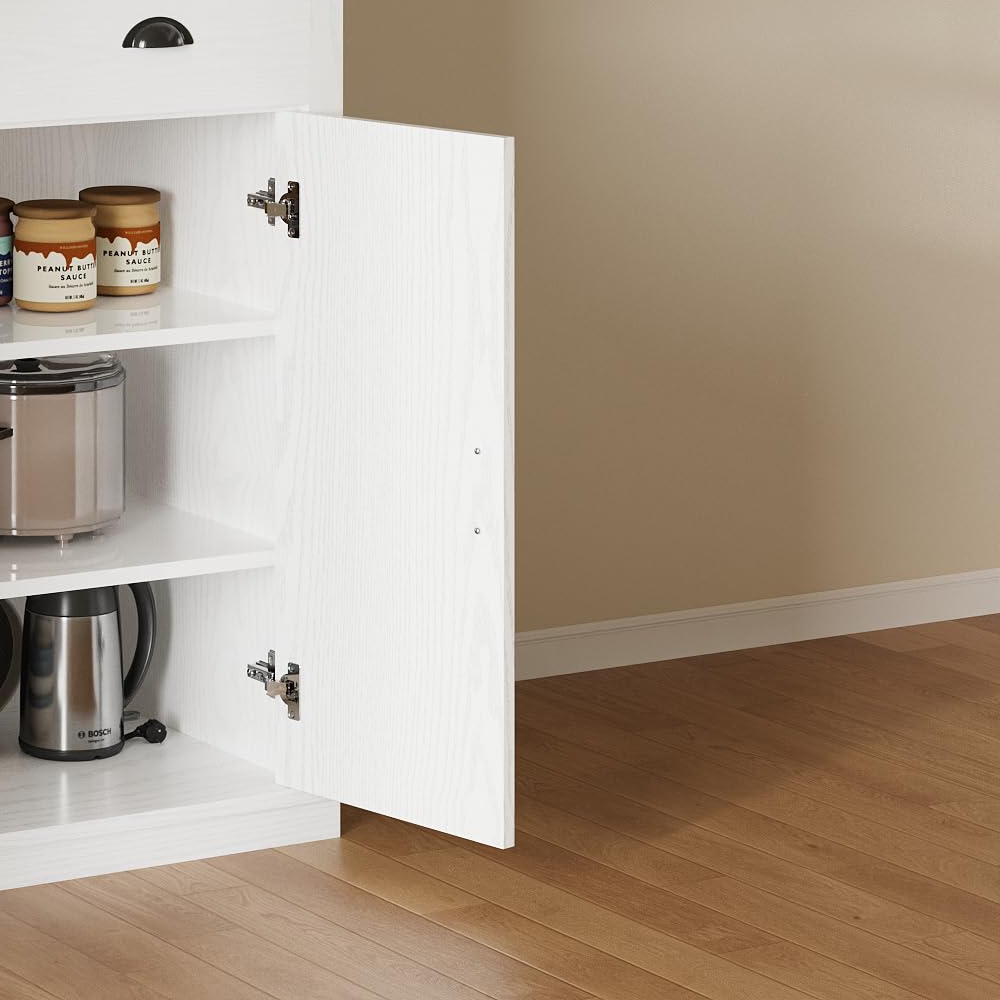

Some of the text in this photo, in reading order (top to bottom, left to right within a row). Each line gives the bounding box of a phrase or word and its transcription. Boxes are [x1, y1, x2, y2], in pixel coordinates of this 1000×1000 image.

[125, 257, 152, 265] SAUCE
[60, 273, 87, 281] SAUCE
[88, 727, 112, 738] BOSCH
